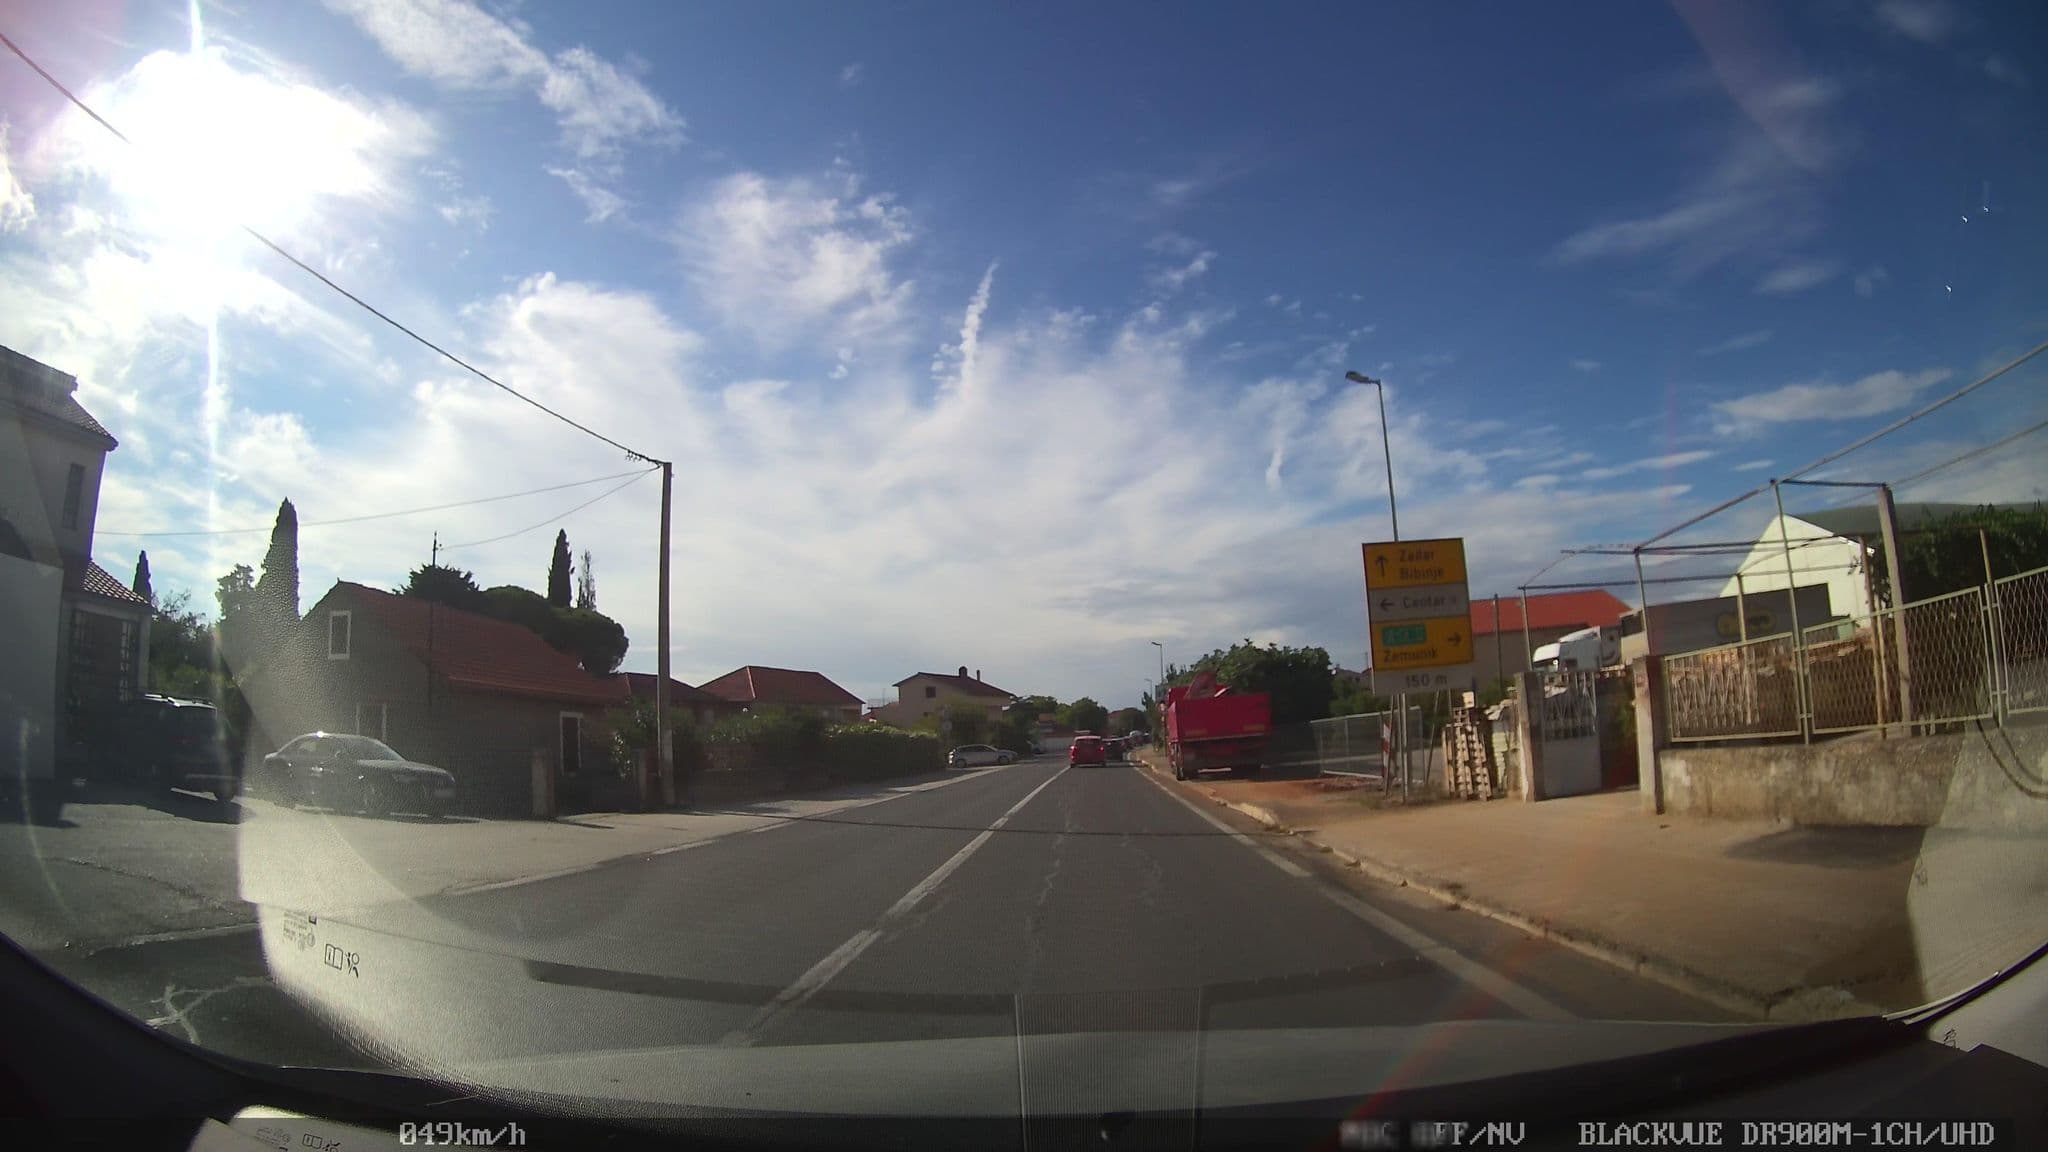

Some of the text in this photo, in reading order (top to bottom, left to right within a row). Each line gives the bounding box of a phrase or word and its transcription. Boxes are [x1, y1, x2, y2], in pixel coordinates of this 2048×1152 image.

[1399, 549, 1435, 562] Zadar
[1402, 595, 1445, 609] Centar
[1405, 673, 1448, 688] 150 m
